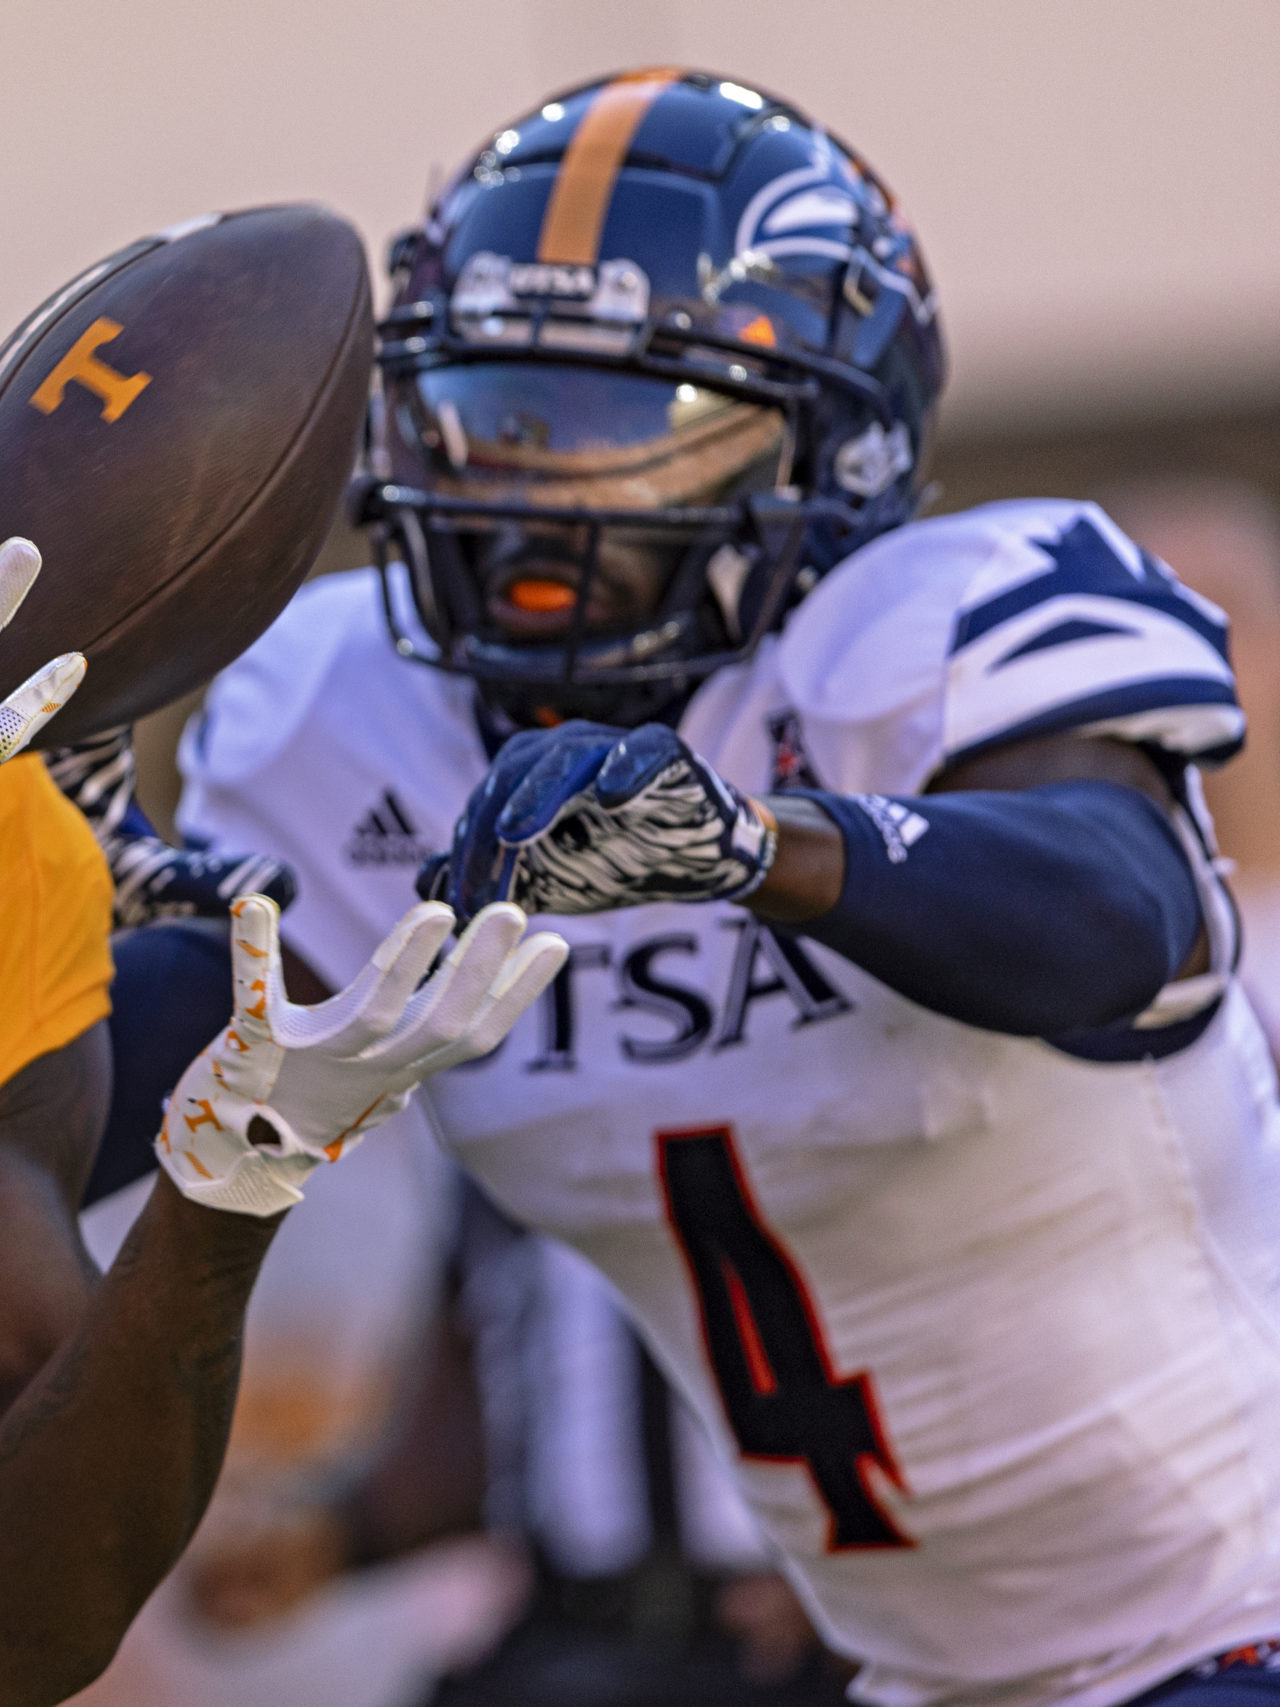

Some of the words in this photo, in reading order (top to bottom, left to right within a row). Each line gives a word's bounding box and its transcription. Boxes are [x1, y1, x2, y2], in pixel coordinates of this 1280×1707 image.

[28, 315, 154, 425] T
[417, 917, 858, 1073] TSA
[653, 1121, 921, 1554] 4
